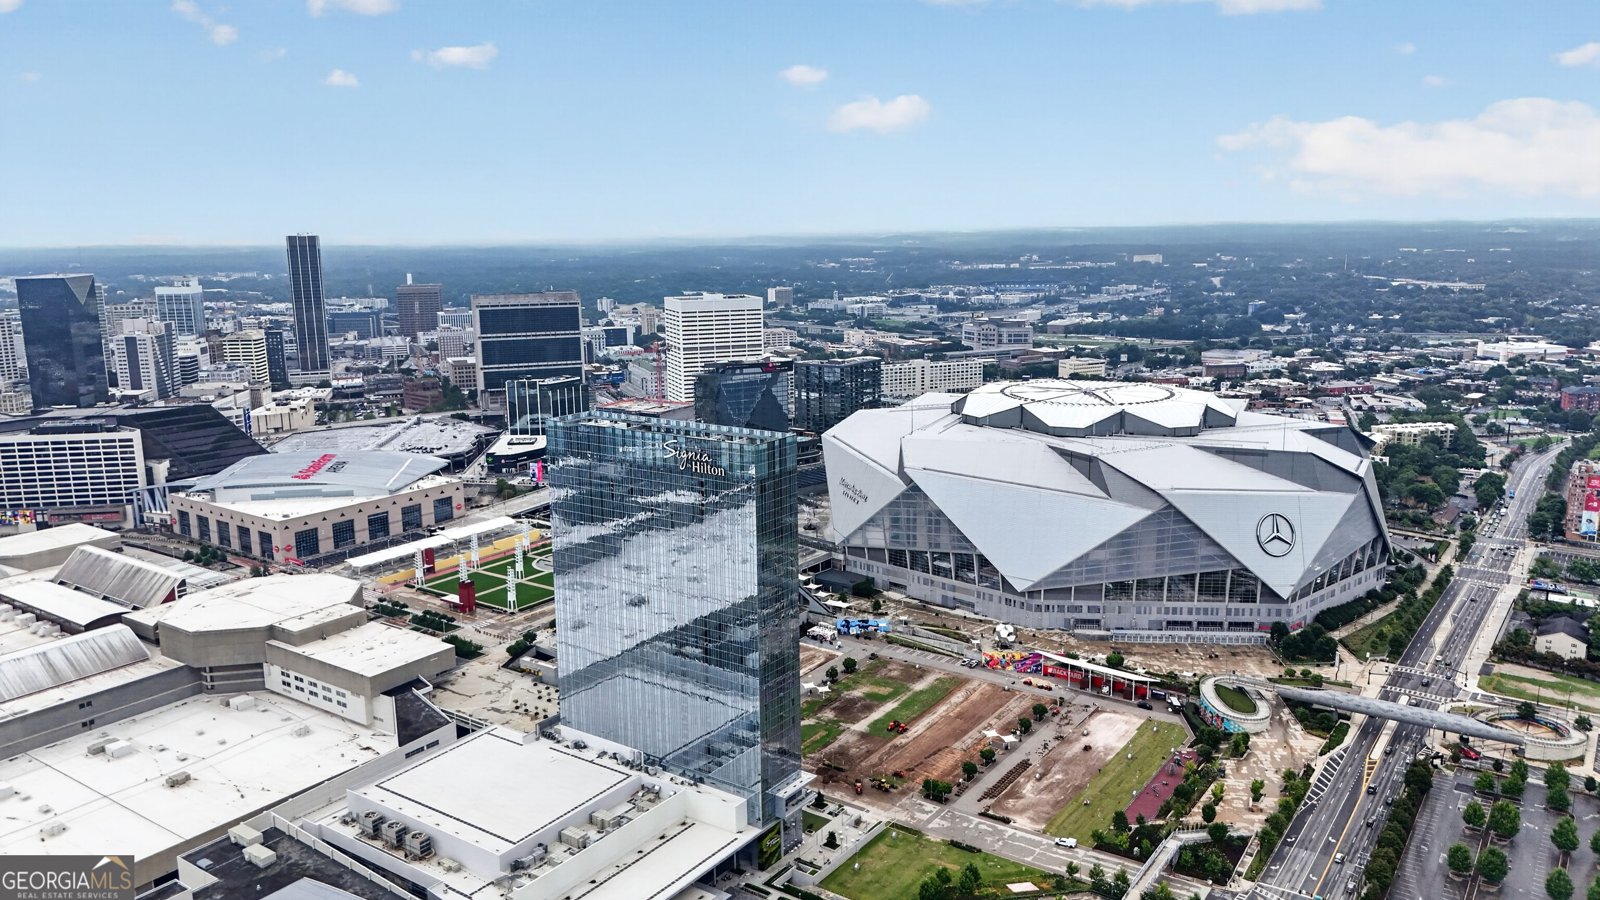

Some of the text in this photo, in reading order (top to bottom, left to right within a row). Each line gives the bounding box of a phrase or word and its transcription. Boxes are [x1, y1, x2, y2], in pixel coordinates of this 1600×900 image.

[663, 439, 712, 470] Signia
[692, 461, 725, 476] Hilton
[1052, 668, 1082, 679] BACKARD
